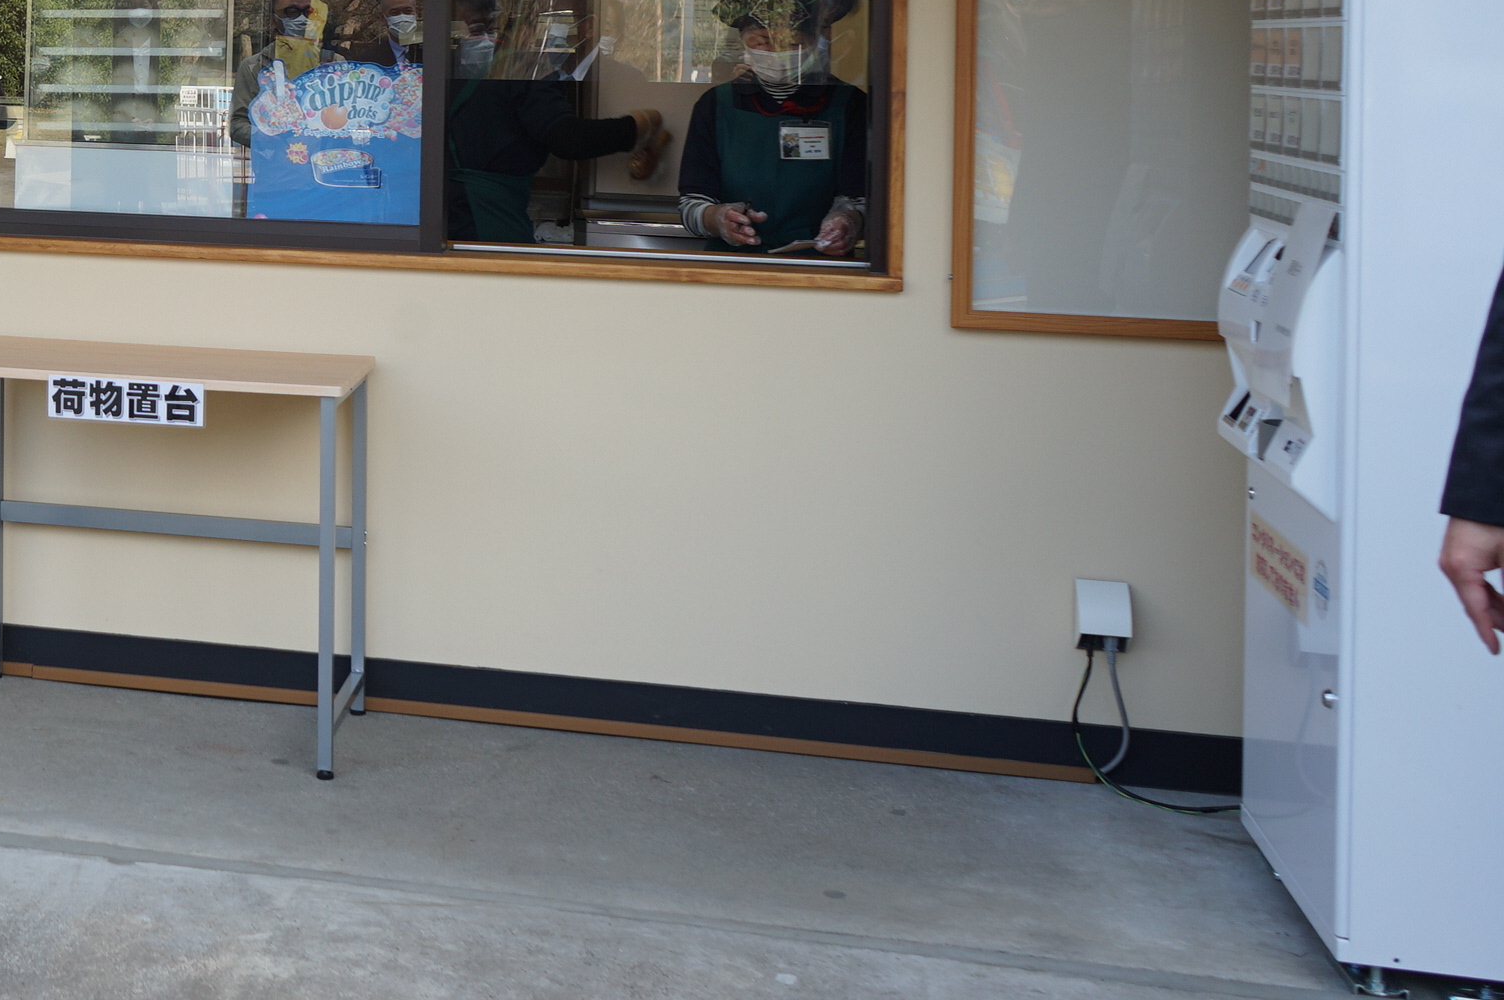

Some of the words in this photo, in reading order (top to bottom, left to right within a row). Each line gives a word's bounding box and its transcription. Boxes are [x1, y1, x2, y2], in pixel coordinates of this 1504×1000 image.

[347, 103, 379, 121] dots
[321, 158, 363, 174] Rainbow
[52, 378, 199, 423] 荷物置台
